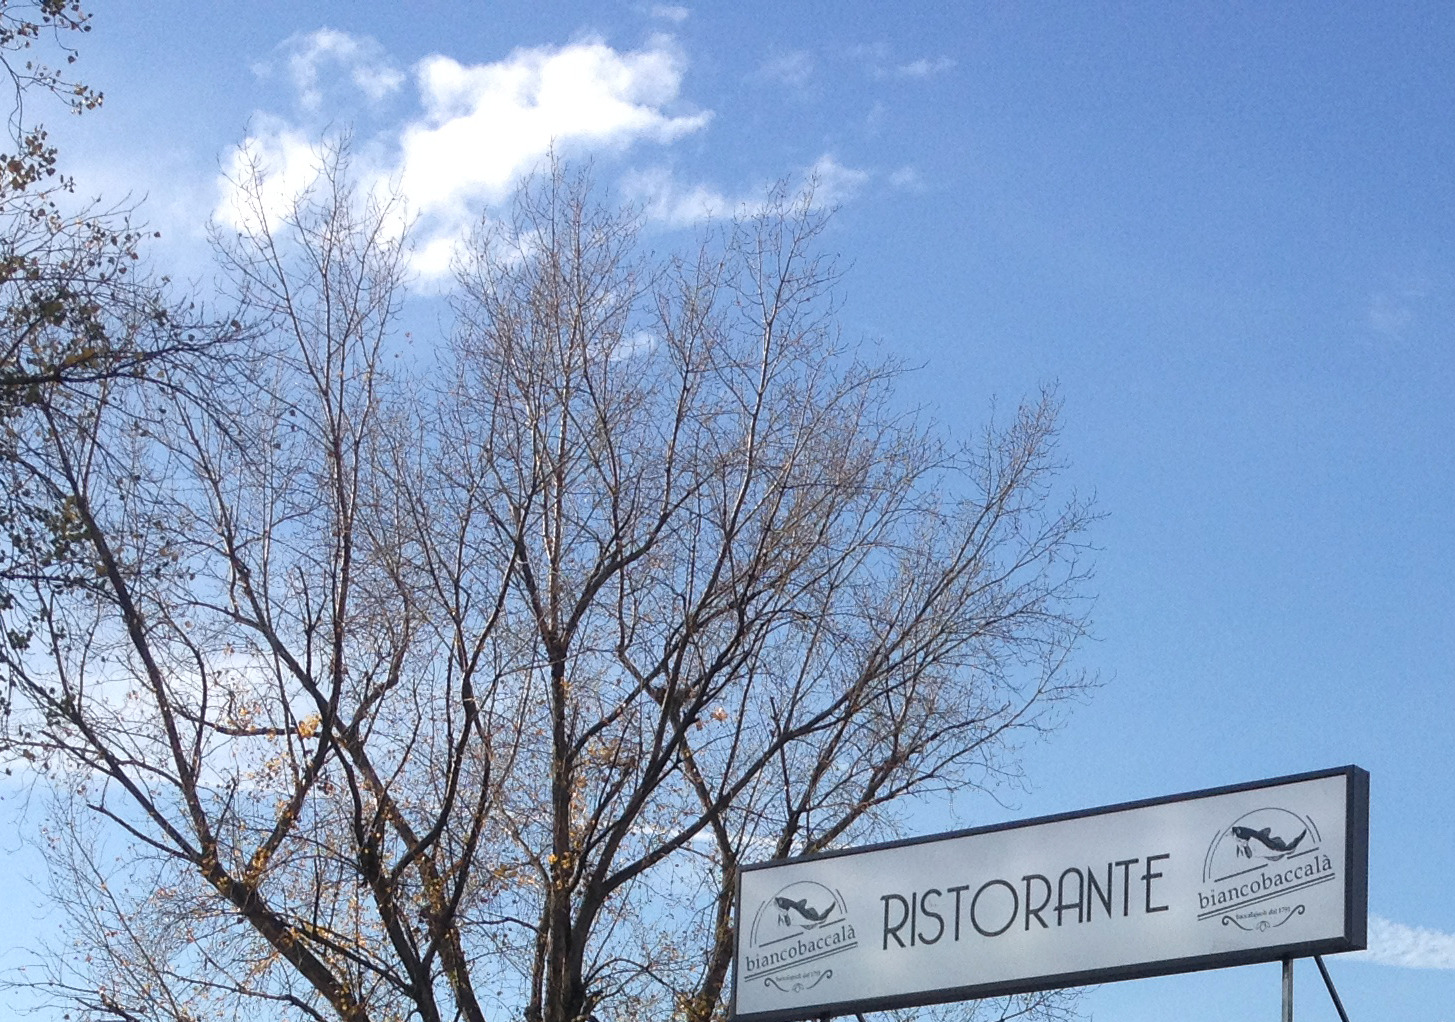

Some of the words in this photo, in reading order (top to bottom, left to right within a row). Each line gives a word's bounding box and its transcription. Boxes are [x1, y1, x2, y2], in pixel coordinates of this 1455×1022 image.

[879, 853, 1170, 951] RISTORANTE
[1197, 854, 1333, 910] biancobaccalà
[745, 924, 857, 972] biancobaccalà
